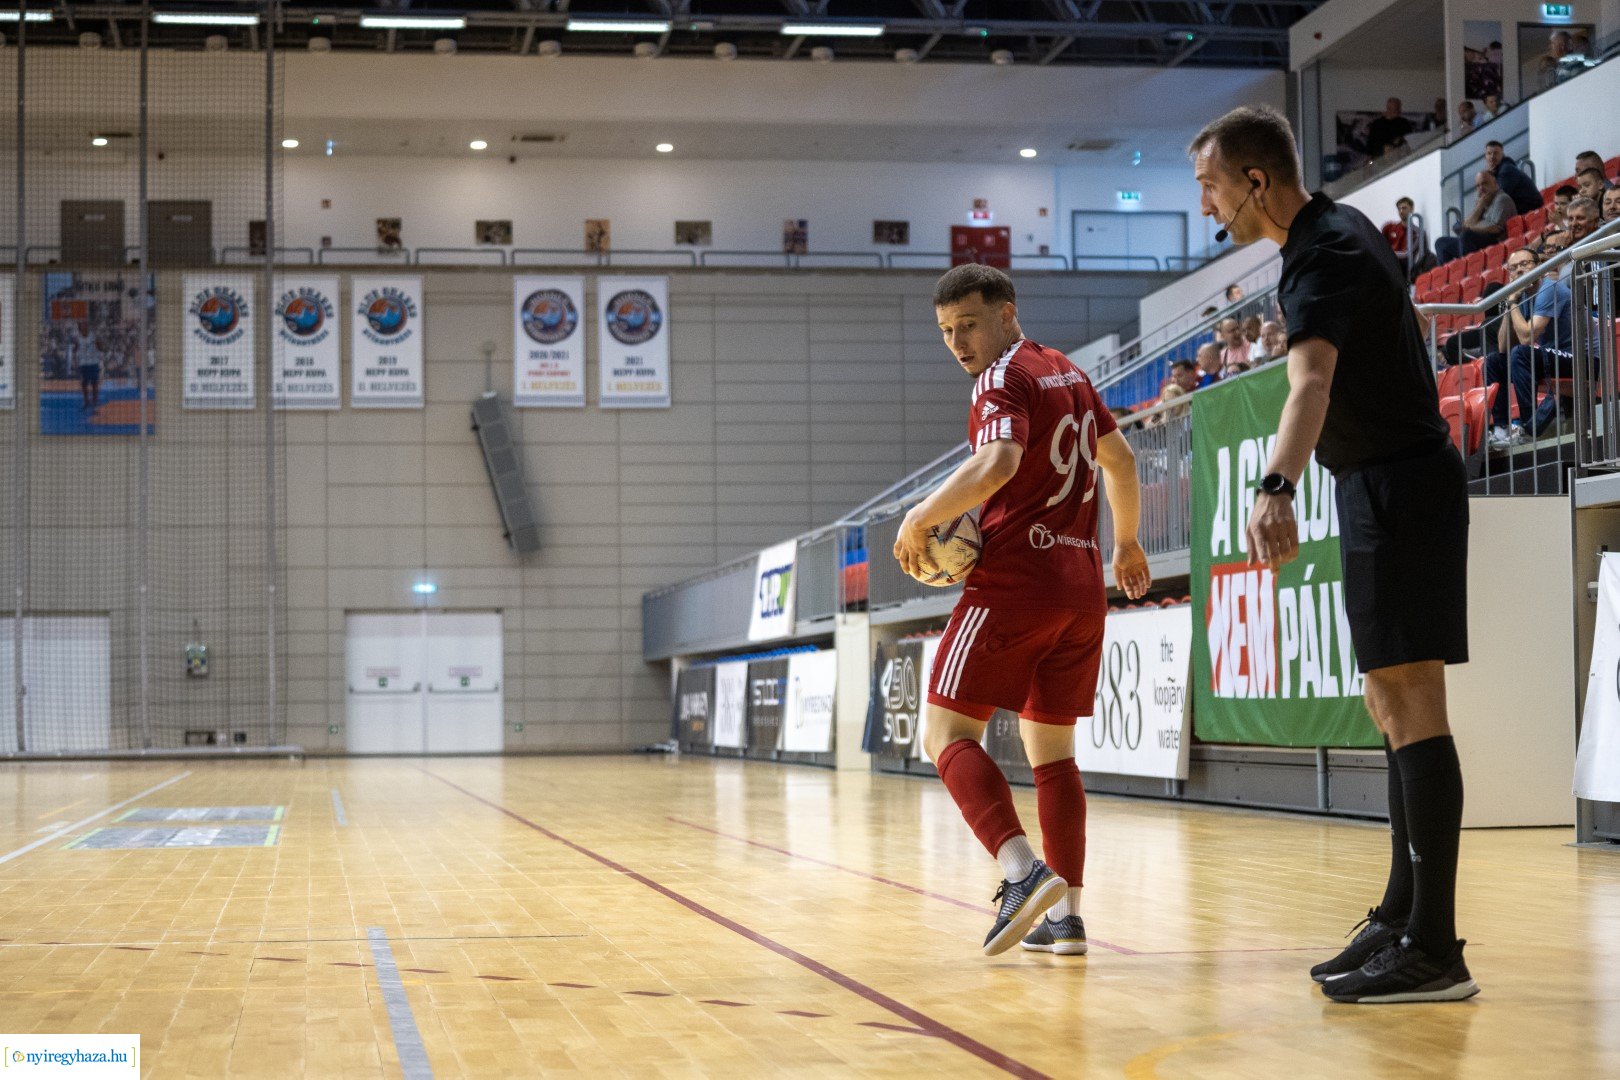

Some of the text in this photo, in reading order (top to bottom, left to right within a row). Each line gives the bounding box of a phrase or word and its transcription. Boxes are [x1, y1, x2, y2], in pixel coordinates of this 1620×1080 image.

[1046, 409, 1098, 507] 99
[1211, 446, 1232, 558] A
[1160, 636, 1174, 663] the
[1208, 568, 1277, 699] NEM
